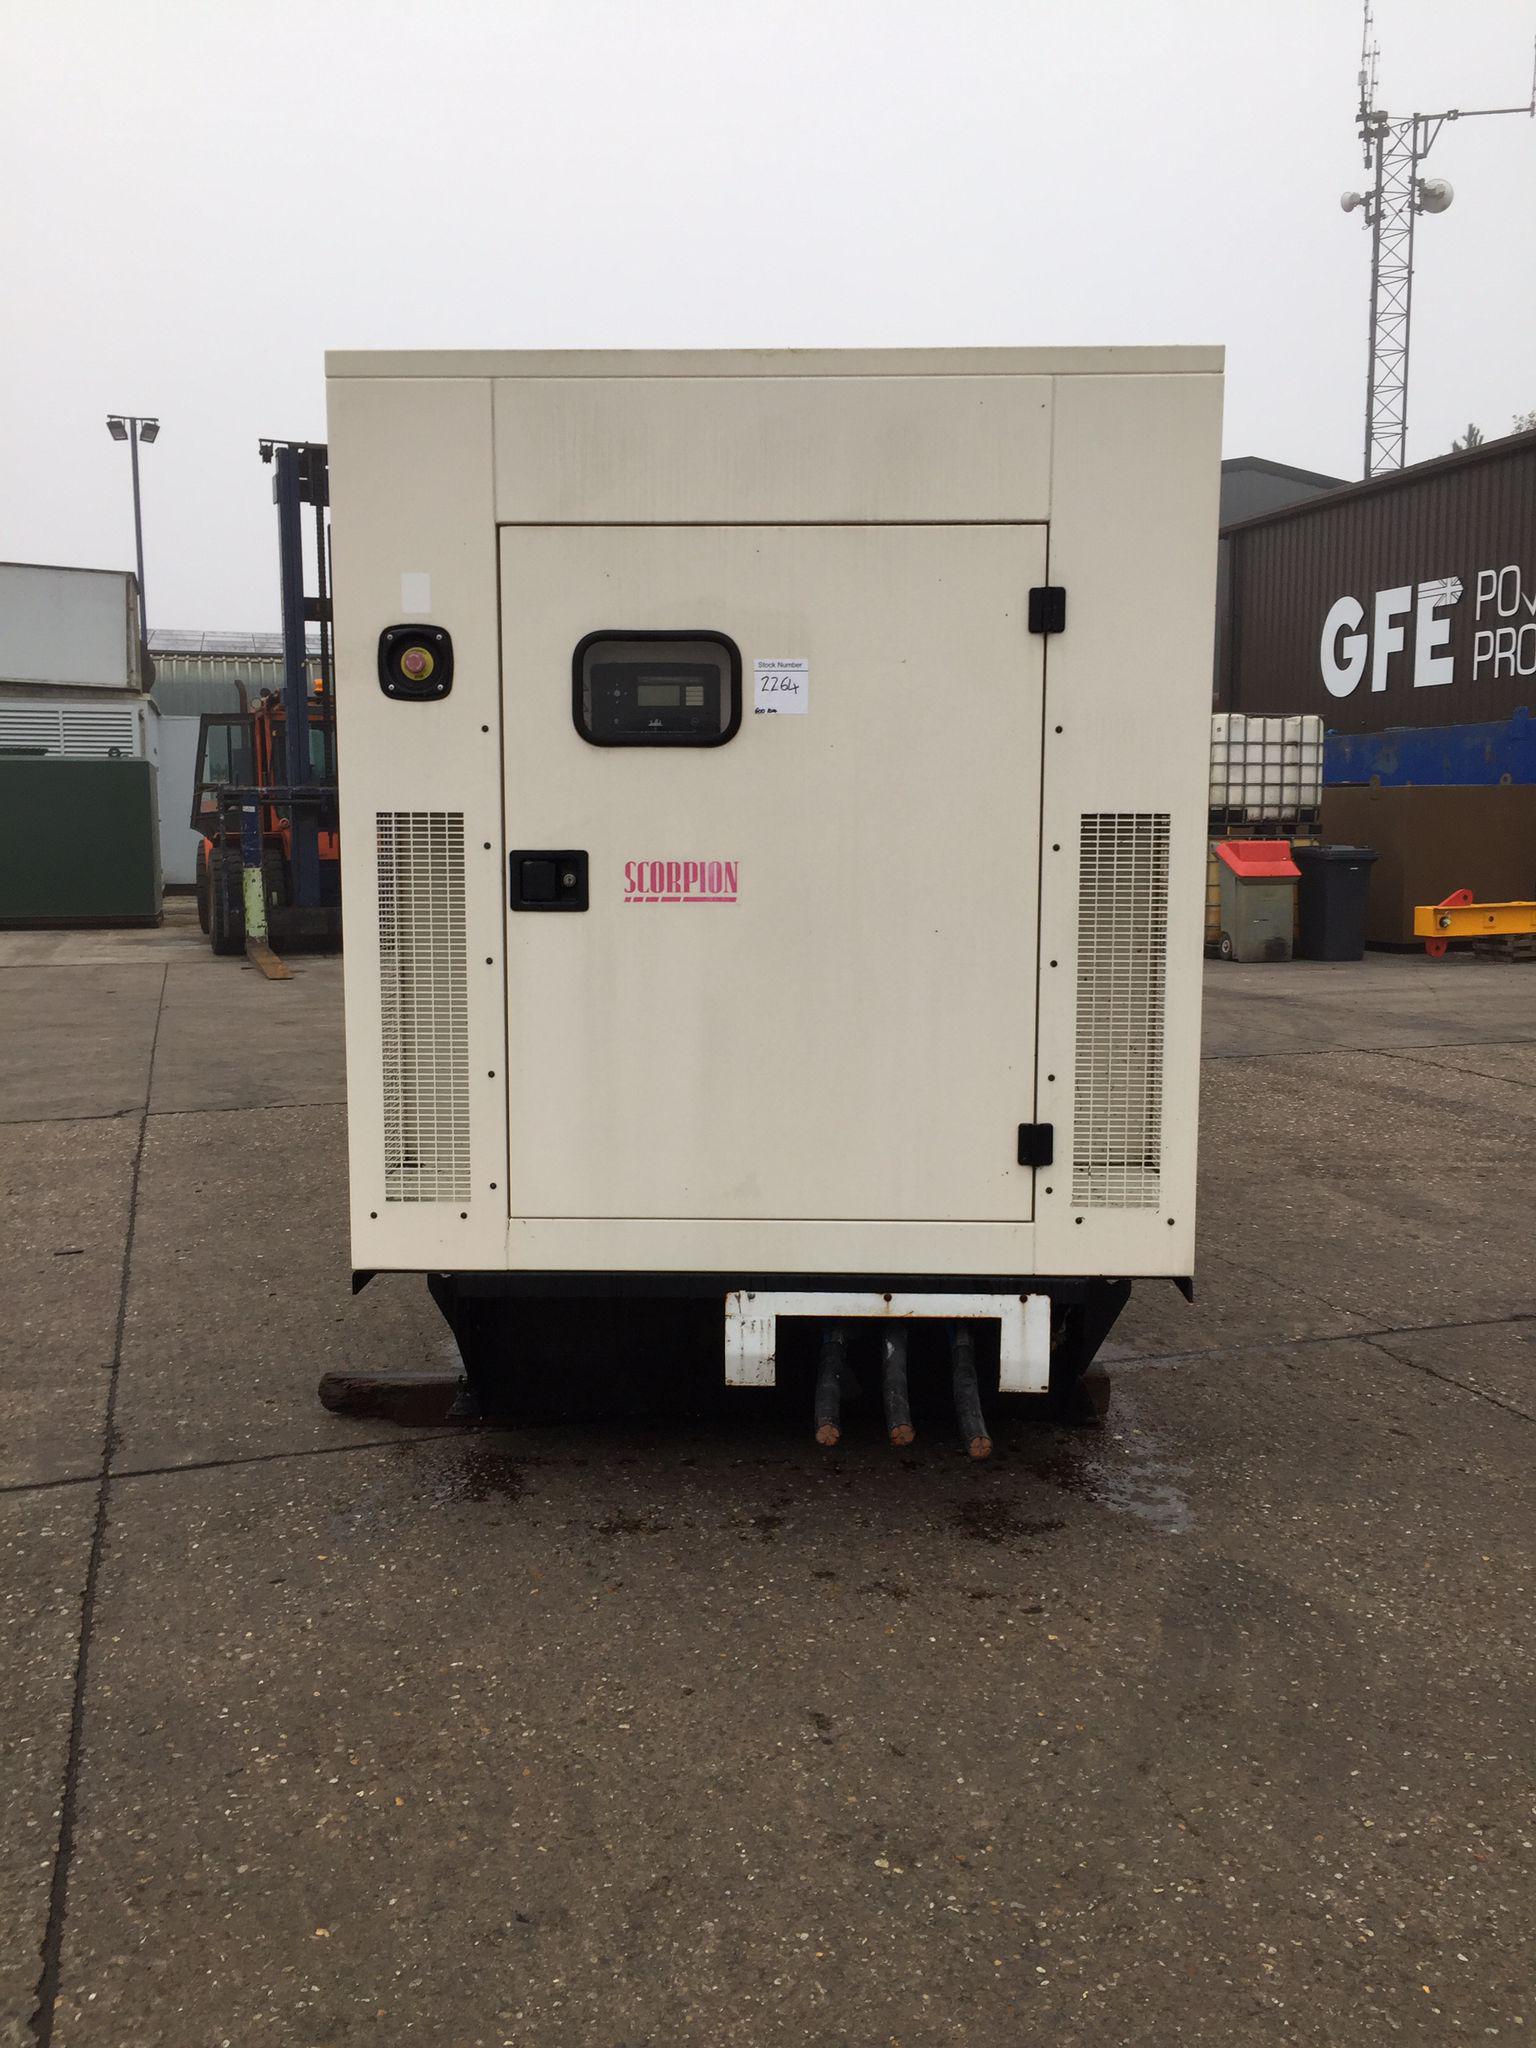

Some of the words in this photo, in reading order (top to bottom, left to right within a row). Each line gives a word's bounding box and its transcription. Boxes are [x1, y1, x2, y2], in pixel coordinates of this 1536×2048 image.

[1320, 575, 1464, 698] GFE
[761, 675, 800, 694] 2264
[624, 860, 739, 893] SCORPION
